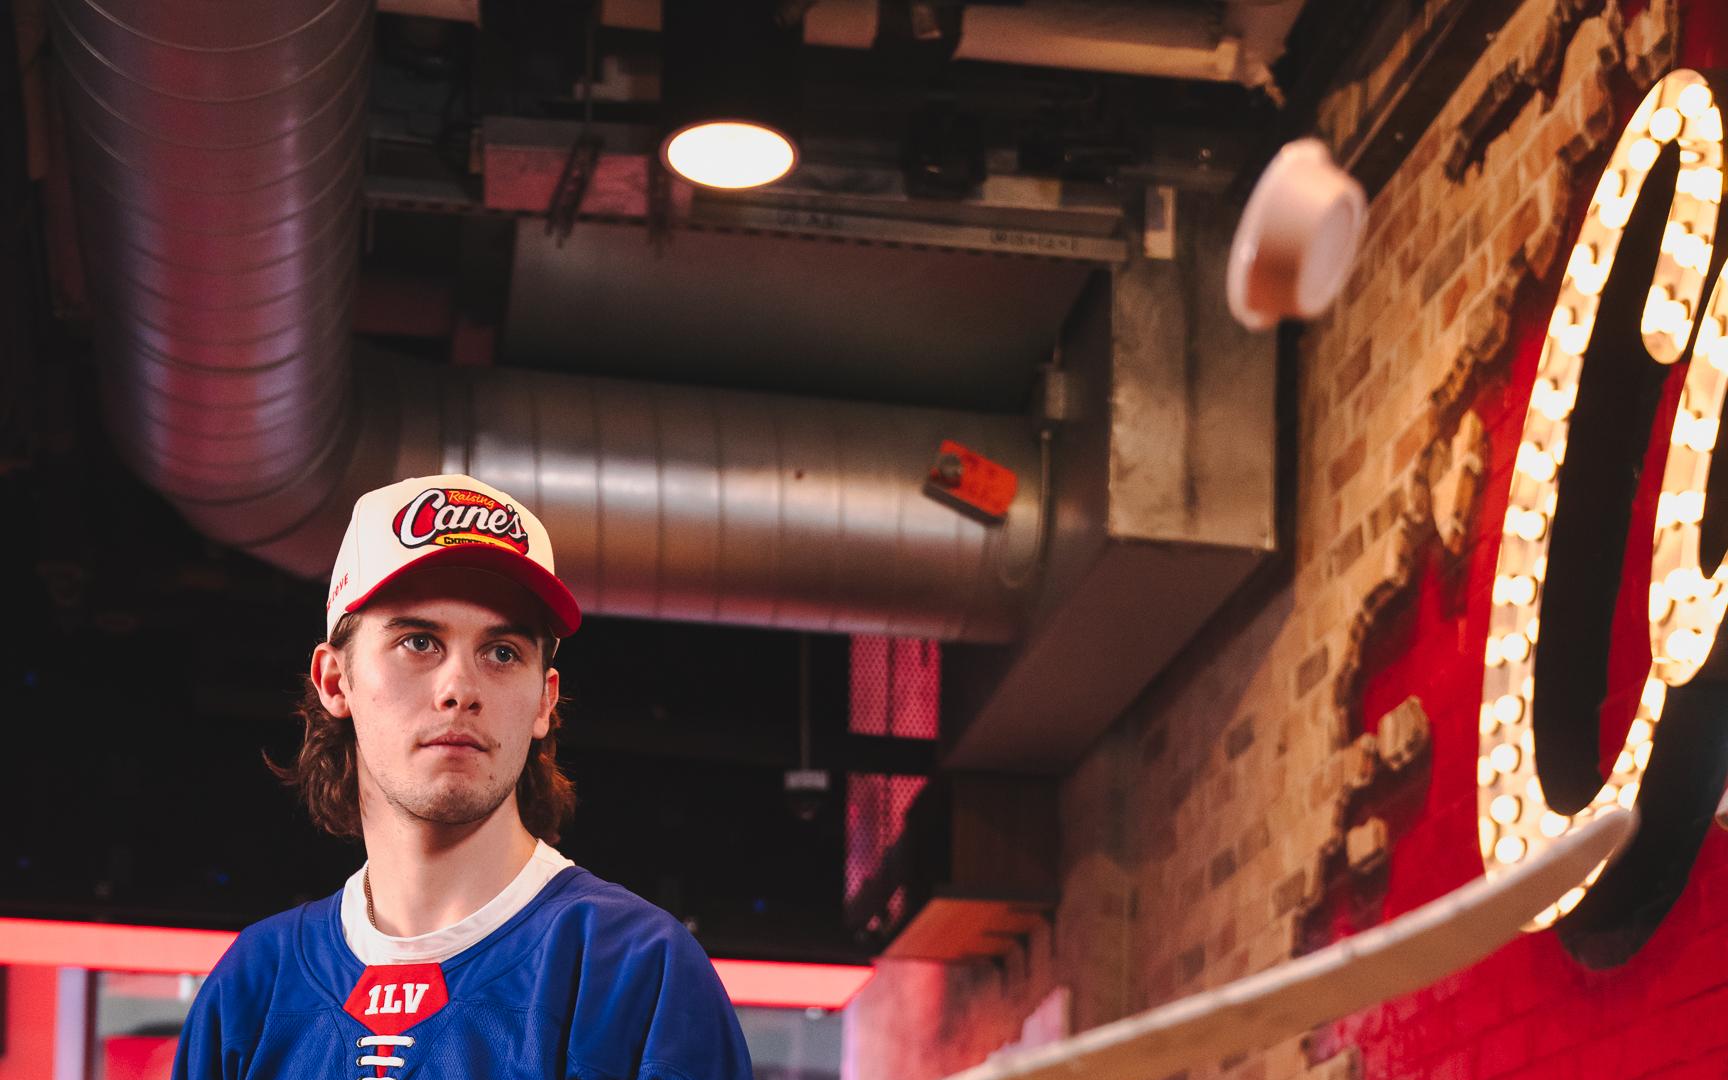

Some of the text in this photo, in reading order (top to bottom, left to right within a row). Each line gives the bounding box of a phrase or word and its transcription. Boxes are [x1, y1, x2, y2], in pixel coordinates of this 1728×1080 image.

[448, 490, 496, 510] Raising
[400, 488, 528, 547] Cane's
[364, 982, 430, 1016] 1LV
